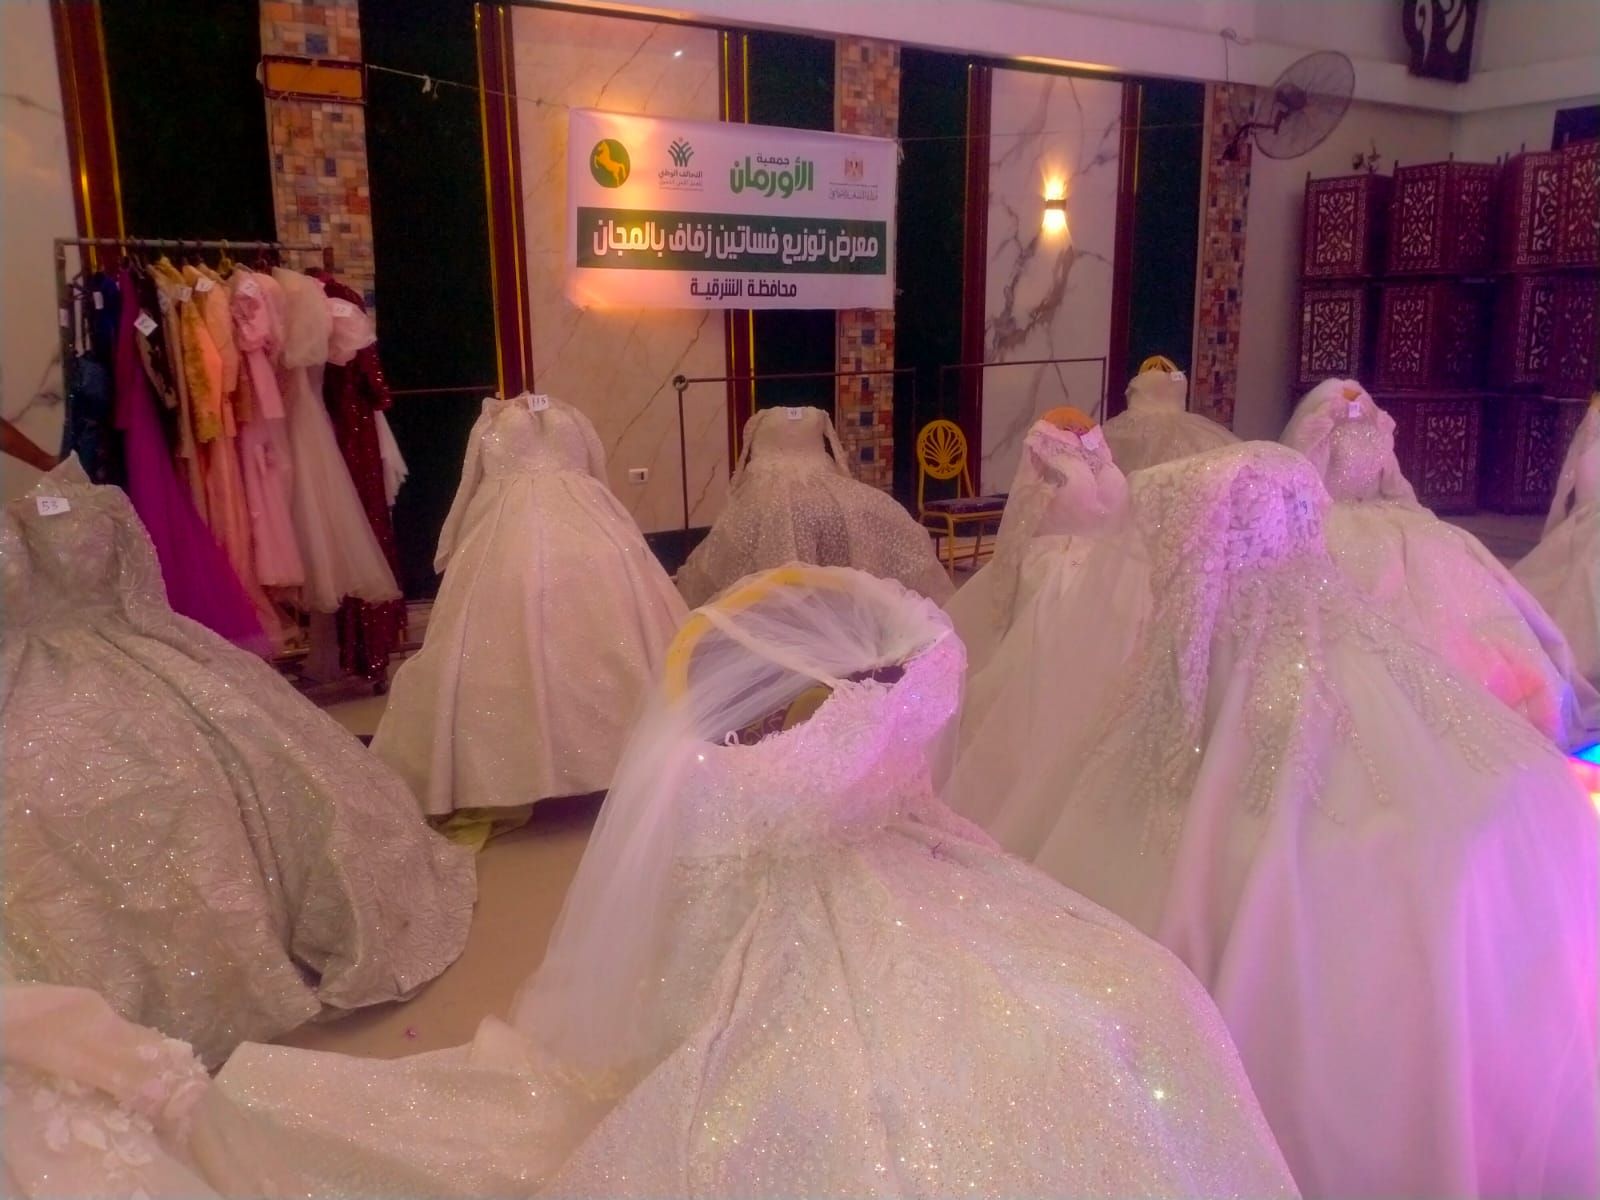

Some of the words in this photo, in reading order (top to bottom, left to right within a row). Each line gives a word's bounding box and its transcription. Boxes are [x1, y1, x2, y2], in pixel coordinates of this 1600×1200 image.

[729, 156, 814, 199] الأورمان
[756, 152, 790, 168] جمعية
[593, 219, 666, 258] بالمجان
[668, 222, 713, 259] زفاف
[715, 224, 779, 260] فساتين
[782, 228, 827, 265] توزيع
[829, 229, 879, 263] معرض
[690, 278, 743, 300] الشرقية
[747, 279, 797, 298] محافظة
